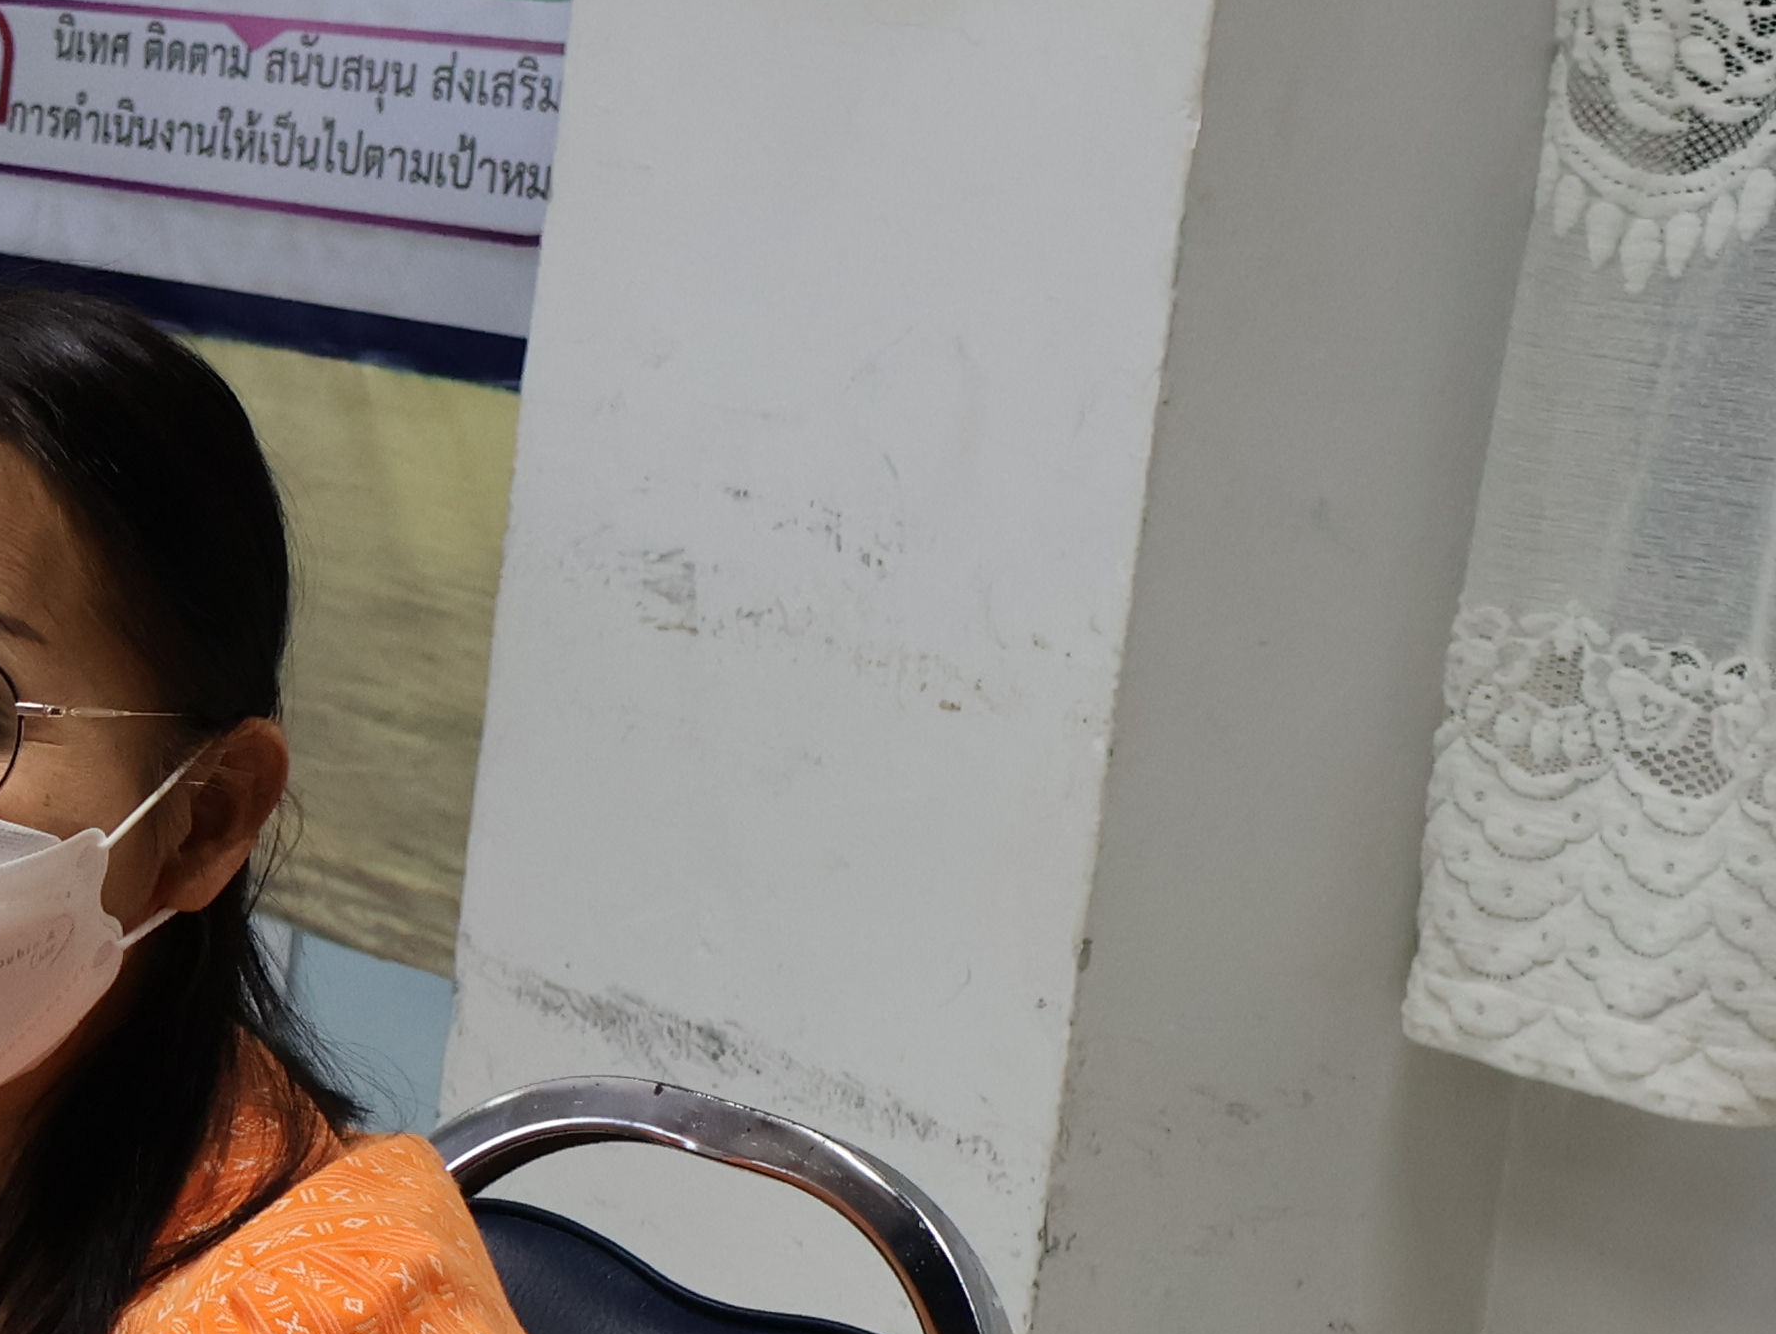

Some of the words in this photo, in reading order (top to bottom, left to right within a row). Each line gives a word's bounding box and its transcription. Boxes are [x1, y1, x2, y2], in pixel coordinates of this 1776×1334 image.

[53, 12, 131, 66] นิเทศ
[142, 19, 251, 81] ติดตาม
[263, 33, 418, 115] สนับสนุน
[430, 50, 563, 116] ส่งเสริม
